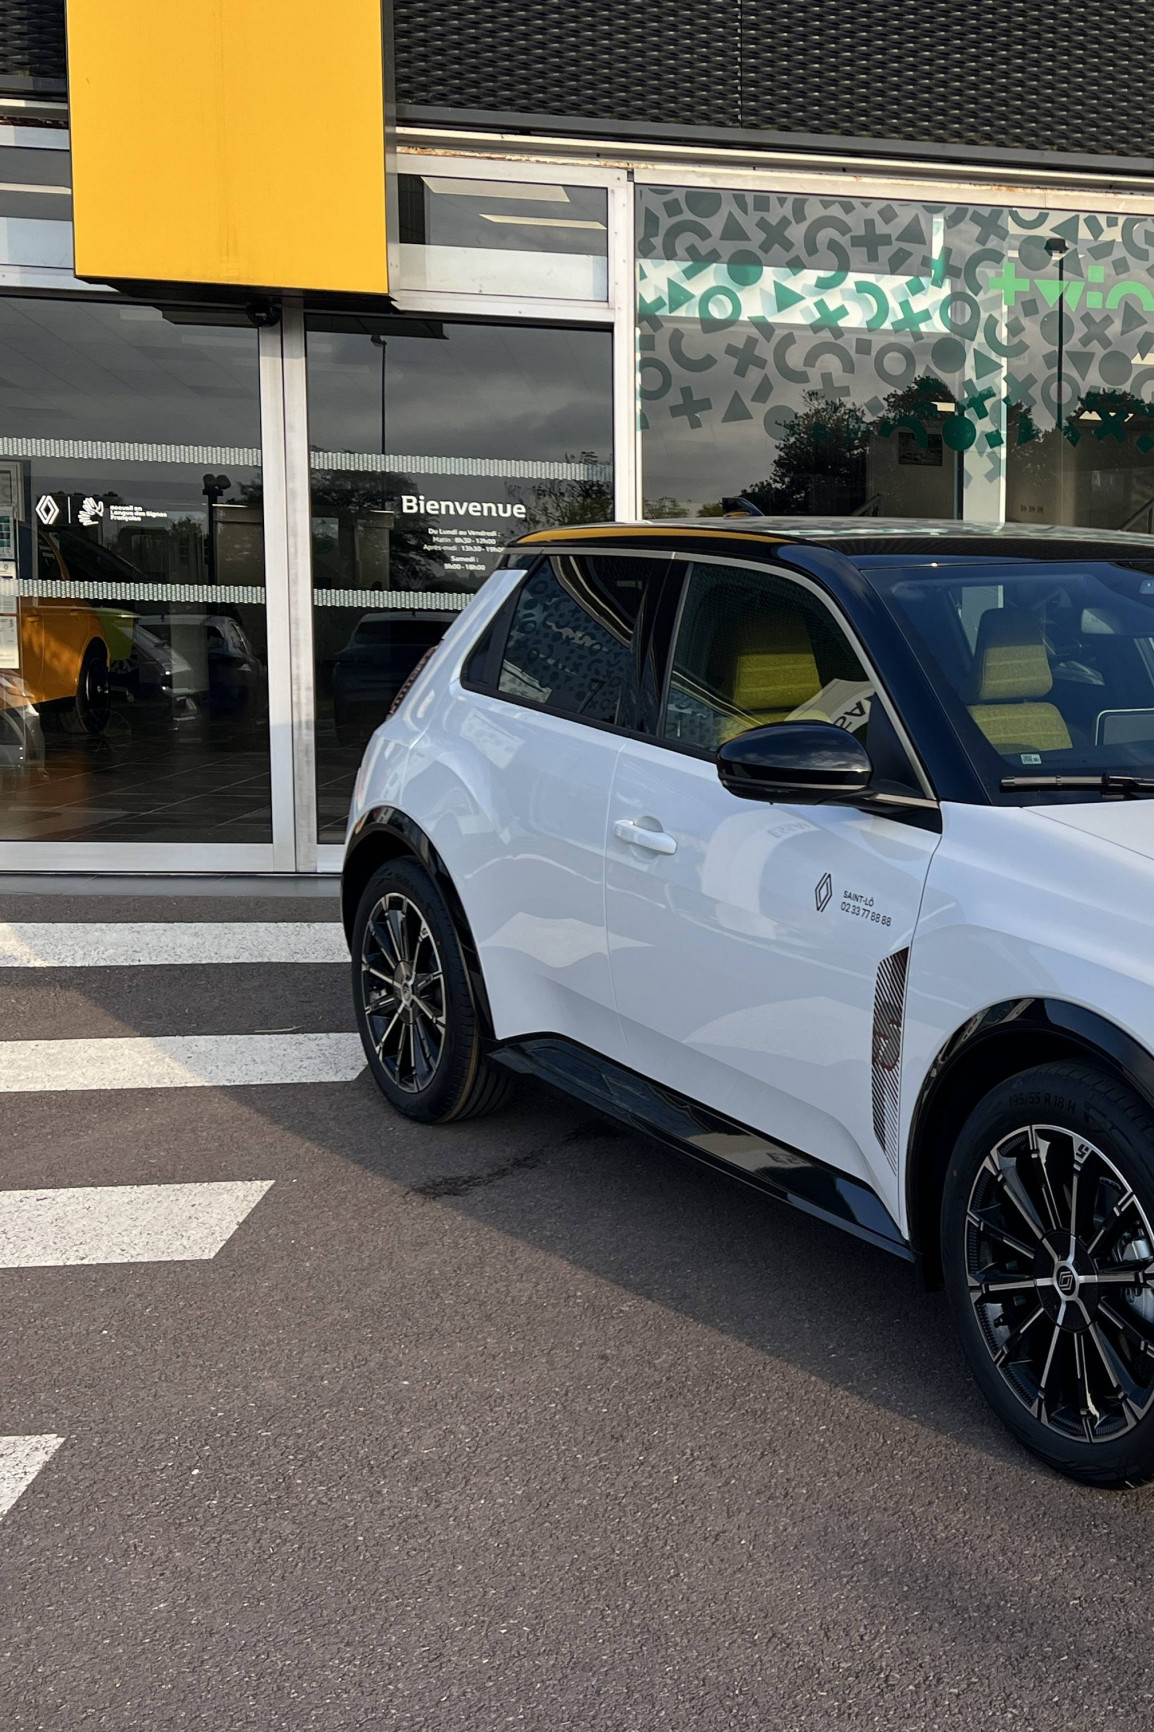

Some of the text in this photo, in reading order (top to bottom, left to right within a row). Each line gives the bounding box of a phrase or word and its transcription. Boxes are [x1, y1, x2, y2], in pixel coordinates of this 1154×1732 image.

[401, 495, 526, 518] Bienvenue
[843, 890, 874, 907] SAINT-LÔ
[841, 901, 892, 927] 02 33 77 88 88
[1044, 1092, 1051, 1104] R
